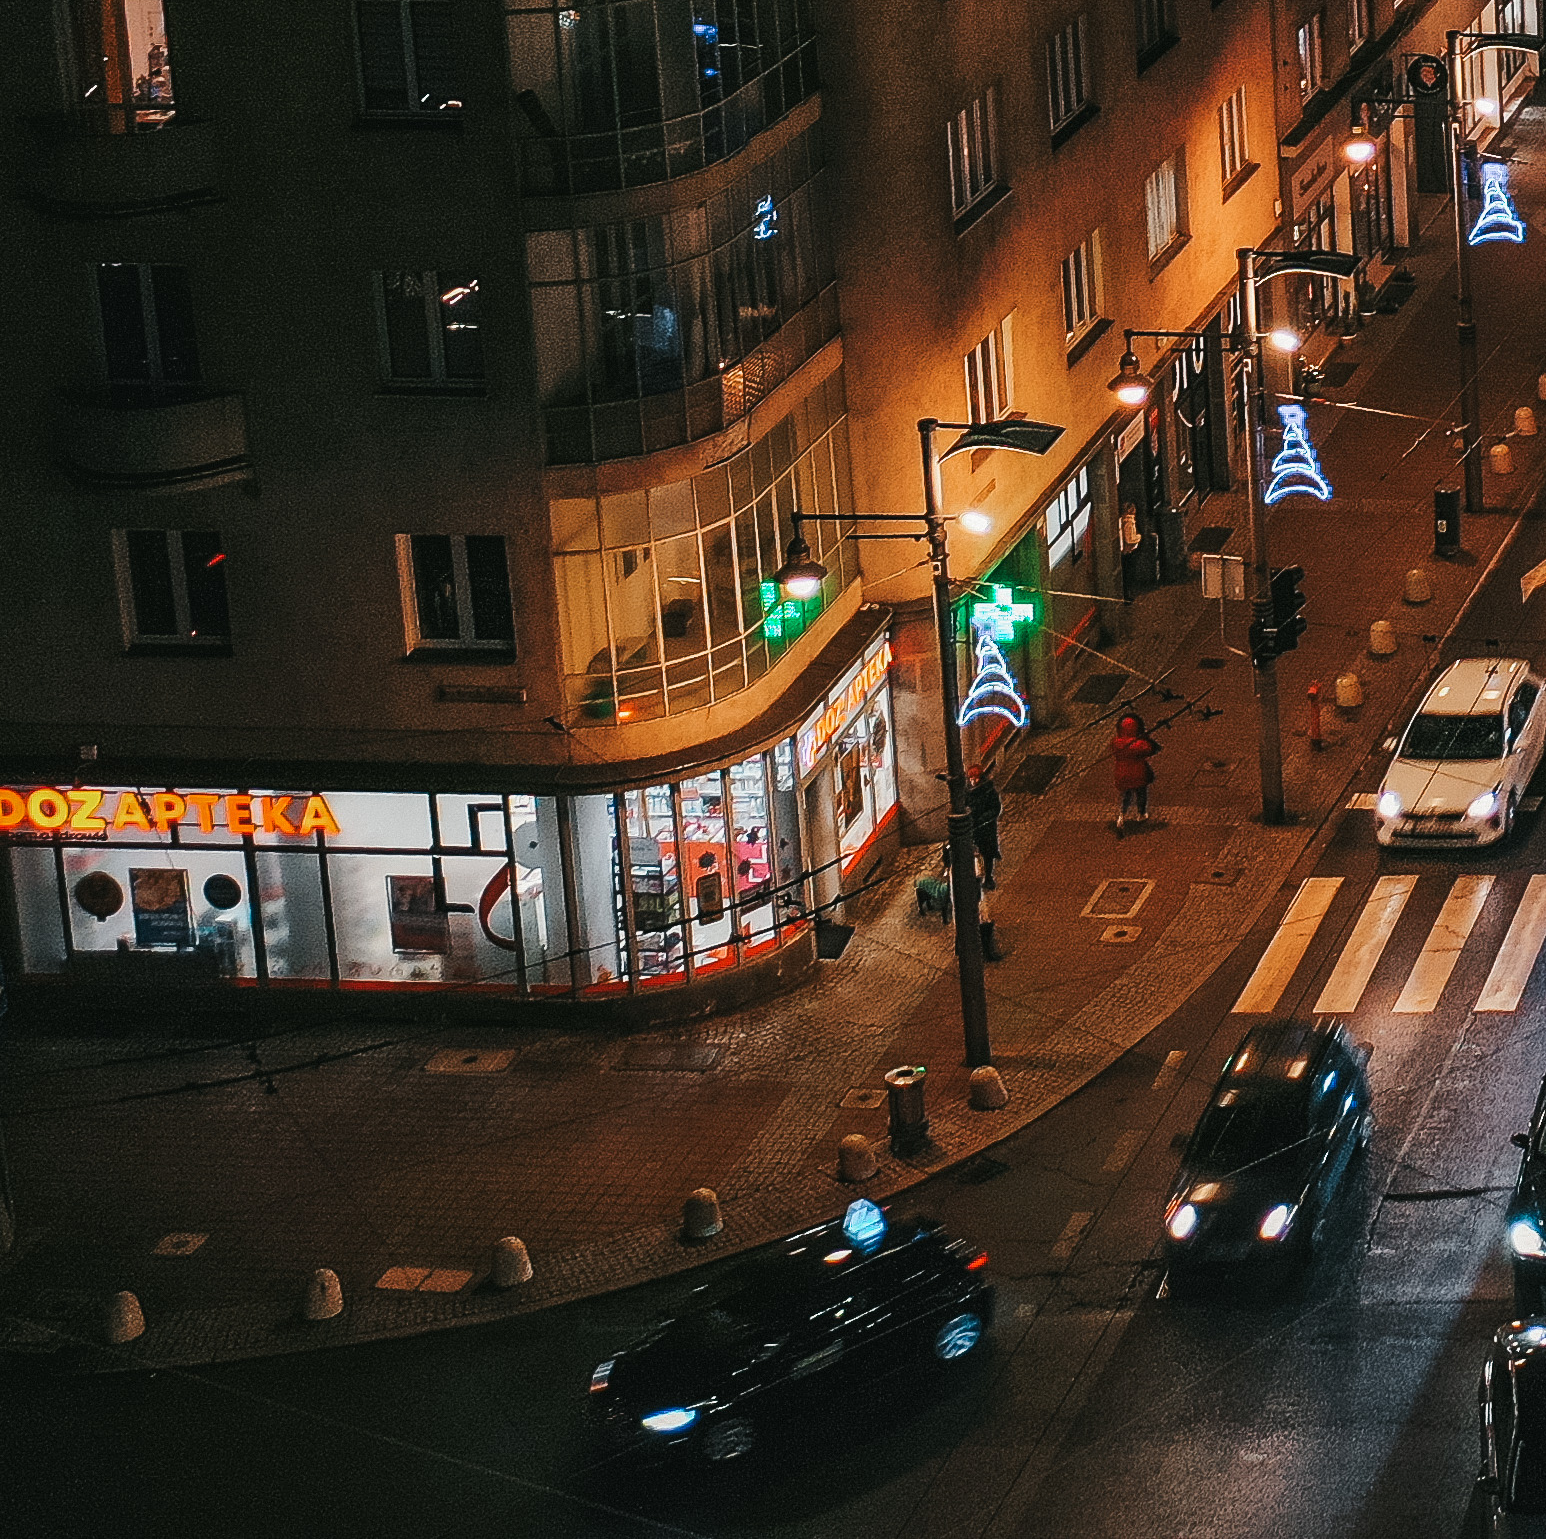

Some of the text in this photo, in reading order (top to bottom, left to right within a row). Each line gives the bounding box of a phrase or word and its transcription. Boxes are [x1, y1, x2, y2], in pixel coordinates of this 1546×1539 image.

[815, 641, 893, 746] DOZ APTEKA
[0, 789, 342, 835] DOZ APTEKA
